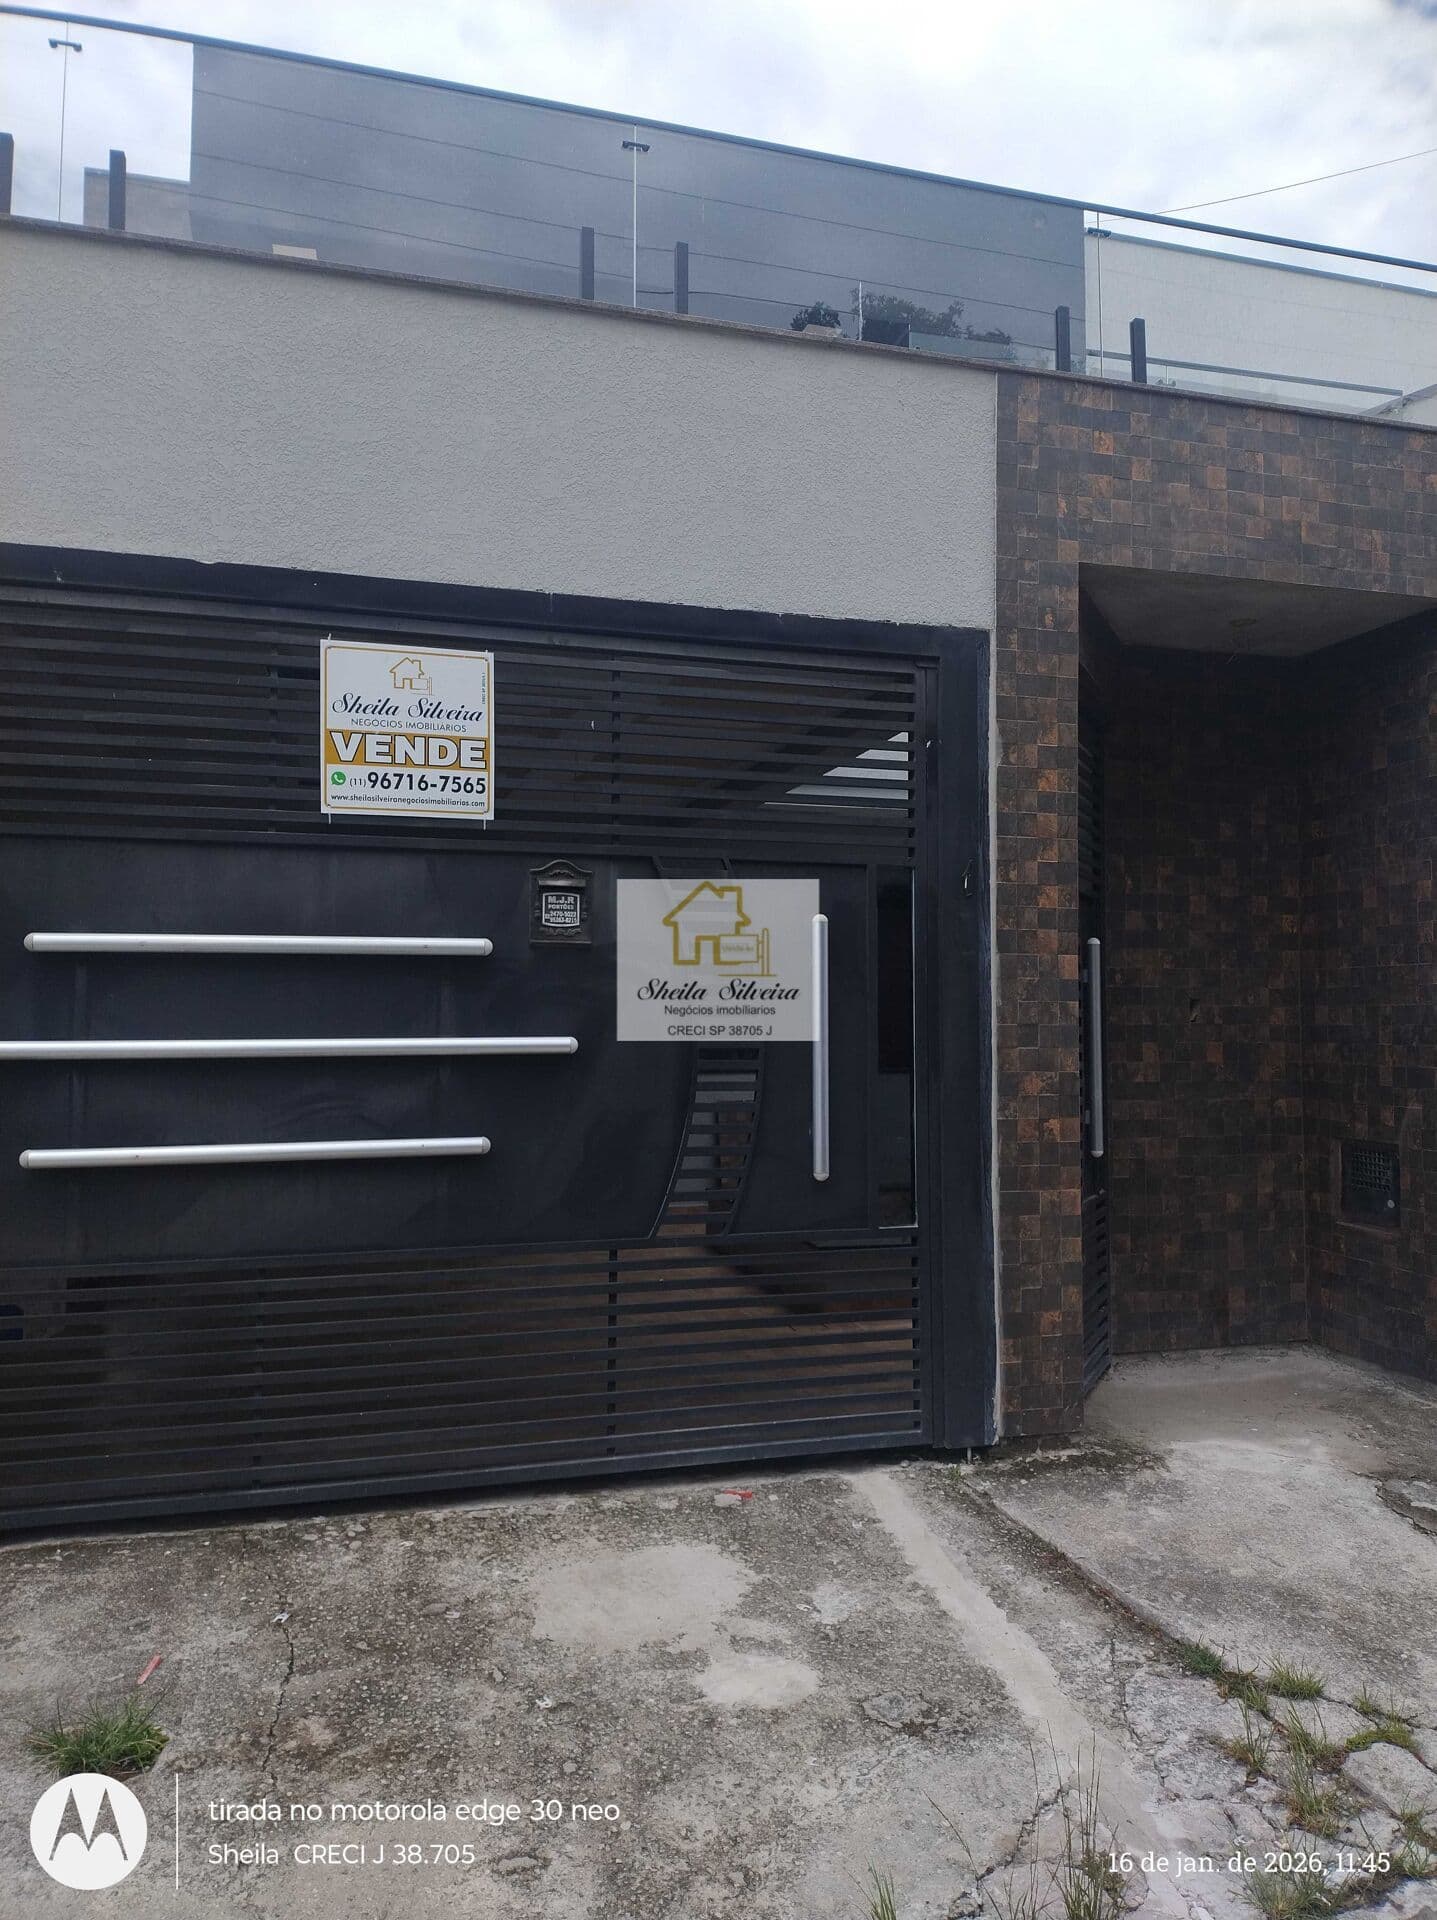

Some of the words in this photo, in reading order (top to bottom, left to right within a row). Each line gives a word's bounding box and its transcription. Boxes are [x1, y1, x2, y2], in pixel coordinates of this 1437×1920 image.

[332, 692, 399, 716] Sheila
[408, 698, 483, 722] Silveira
[329, 730, 487, 769] VENDE
[367, 771, 486, 795] 96716-7565
